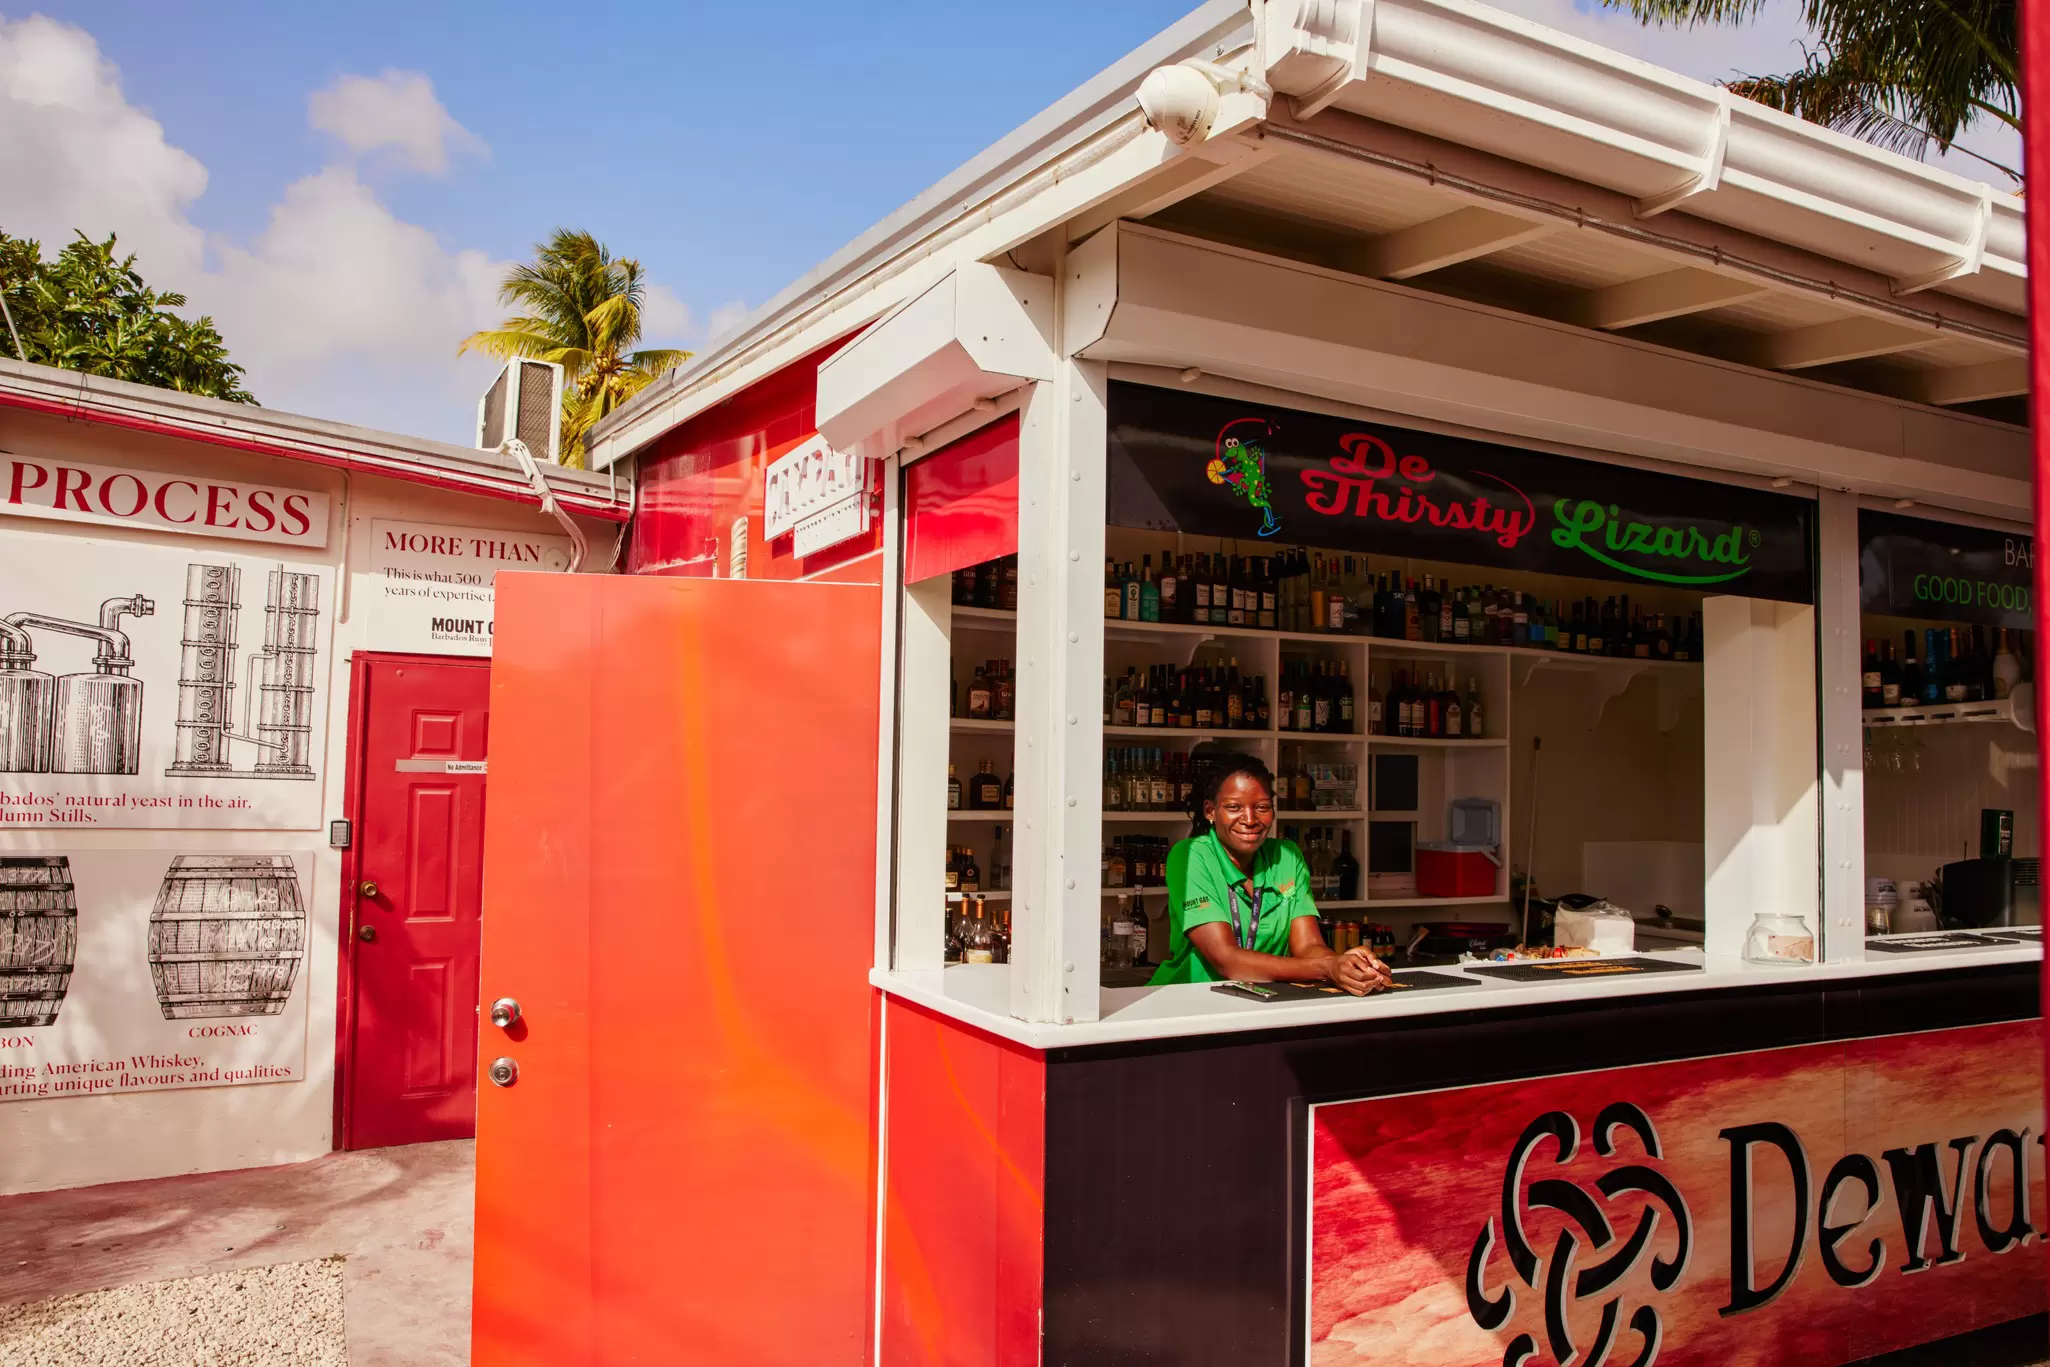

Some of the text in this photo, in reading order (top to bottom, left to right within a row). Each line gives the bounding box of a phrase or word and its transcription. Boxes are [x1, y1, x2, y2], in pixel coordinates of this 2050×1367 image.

[1330, 433, 1435, 482] De
[8, 462, 312, 536] PROCESS
[1300, 469, 1534, 548] Thirsty
[385, 531, 540, 562] MORE THAN
[384, 567, 411, 580] This
[413, 570, 422, 581] is
[425, 571, 452, 584] what
[384, 586, 416, 598] years
[418, 586, 432, 598] of
[433, 590, 486, 601] expertise
[1914, 574, 2032, 616] GOOD FOOD,
[431, 617, 485, 635] MOUNT
[431, 632, 468, 642] Barbados
[469, 634, 488, 643] Rum
[455, 763, 483, 771] Admittance
[65, 794, 126, 807] natural
[131, 796, 173, 810] yeast
[179, 796, 193, 808] in
[199, 795, 224, 809] the
[228, 796, 252, 810] air,
[49, 808, 97, 823] Stills.
[189, 1024, 258, 1038] COGNAC
[41, 1060, 125, 1076] American
[131, 1054, 205, 1069] Whiskey,
[54, 1077, 114, 1093] unique
[120, 1072, 185, 1087] flavours
[189, 1068, 219, 1082] and
[224, 1064, 292, 1083] qualities
[1717, 1121, 2047, 1319] Dewa
